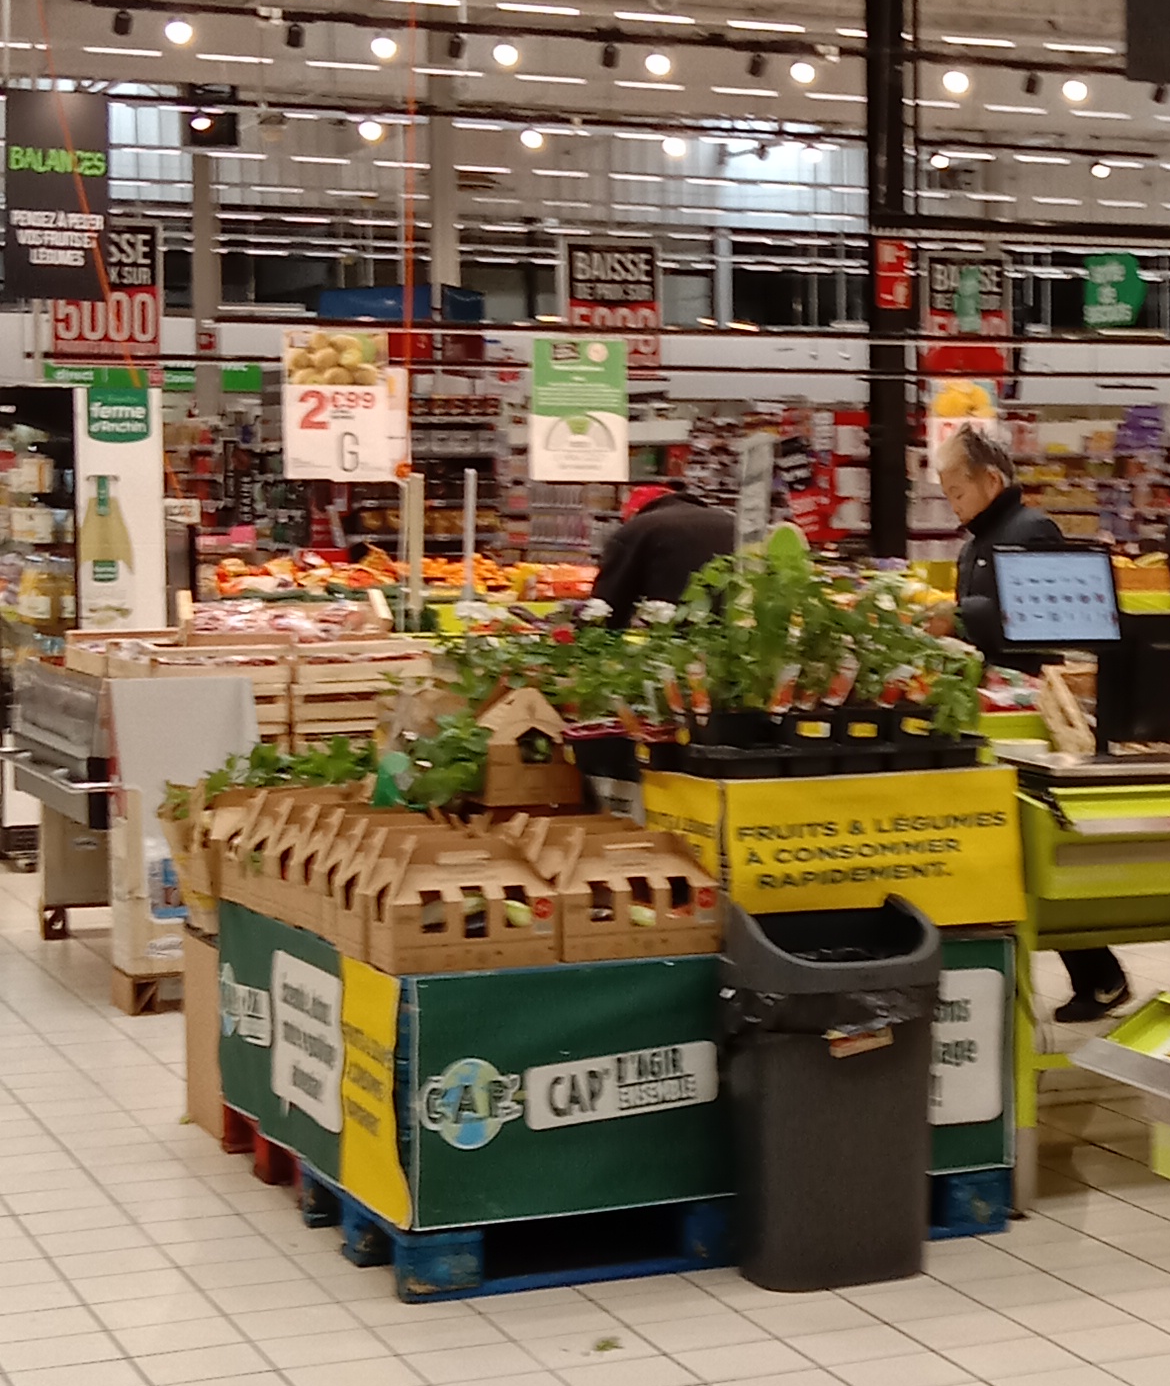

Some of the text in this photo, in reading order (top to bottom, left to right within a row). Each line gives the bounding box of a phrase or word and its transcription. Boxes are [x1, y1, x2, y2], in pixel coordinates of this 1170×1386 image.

[8, 146, 106, 176] BALANCES
[573, 250, 654, 282] BAISSE
[55, 290, 156, 343] 5000
[90, 401, 147, 419] ferme
[735, 819, 839, 843] FRUITS
[874, 810, 1007, 835] LÉGUMES
[773, 837, 960, 865] CONSOMMER
[757, 861, 953, 890] RAPIDEMENT.
